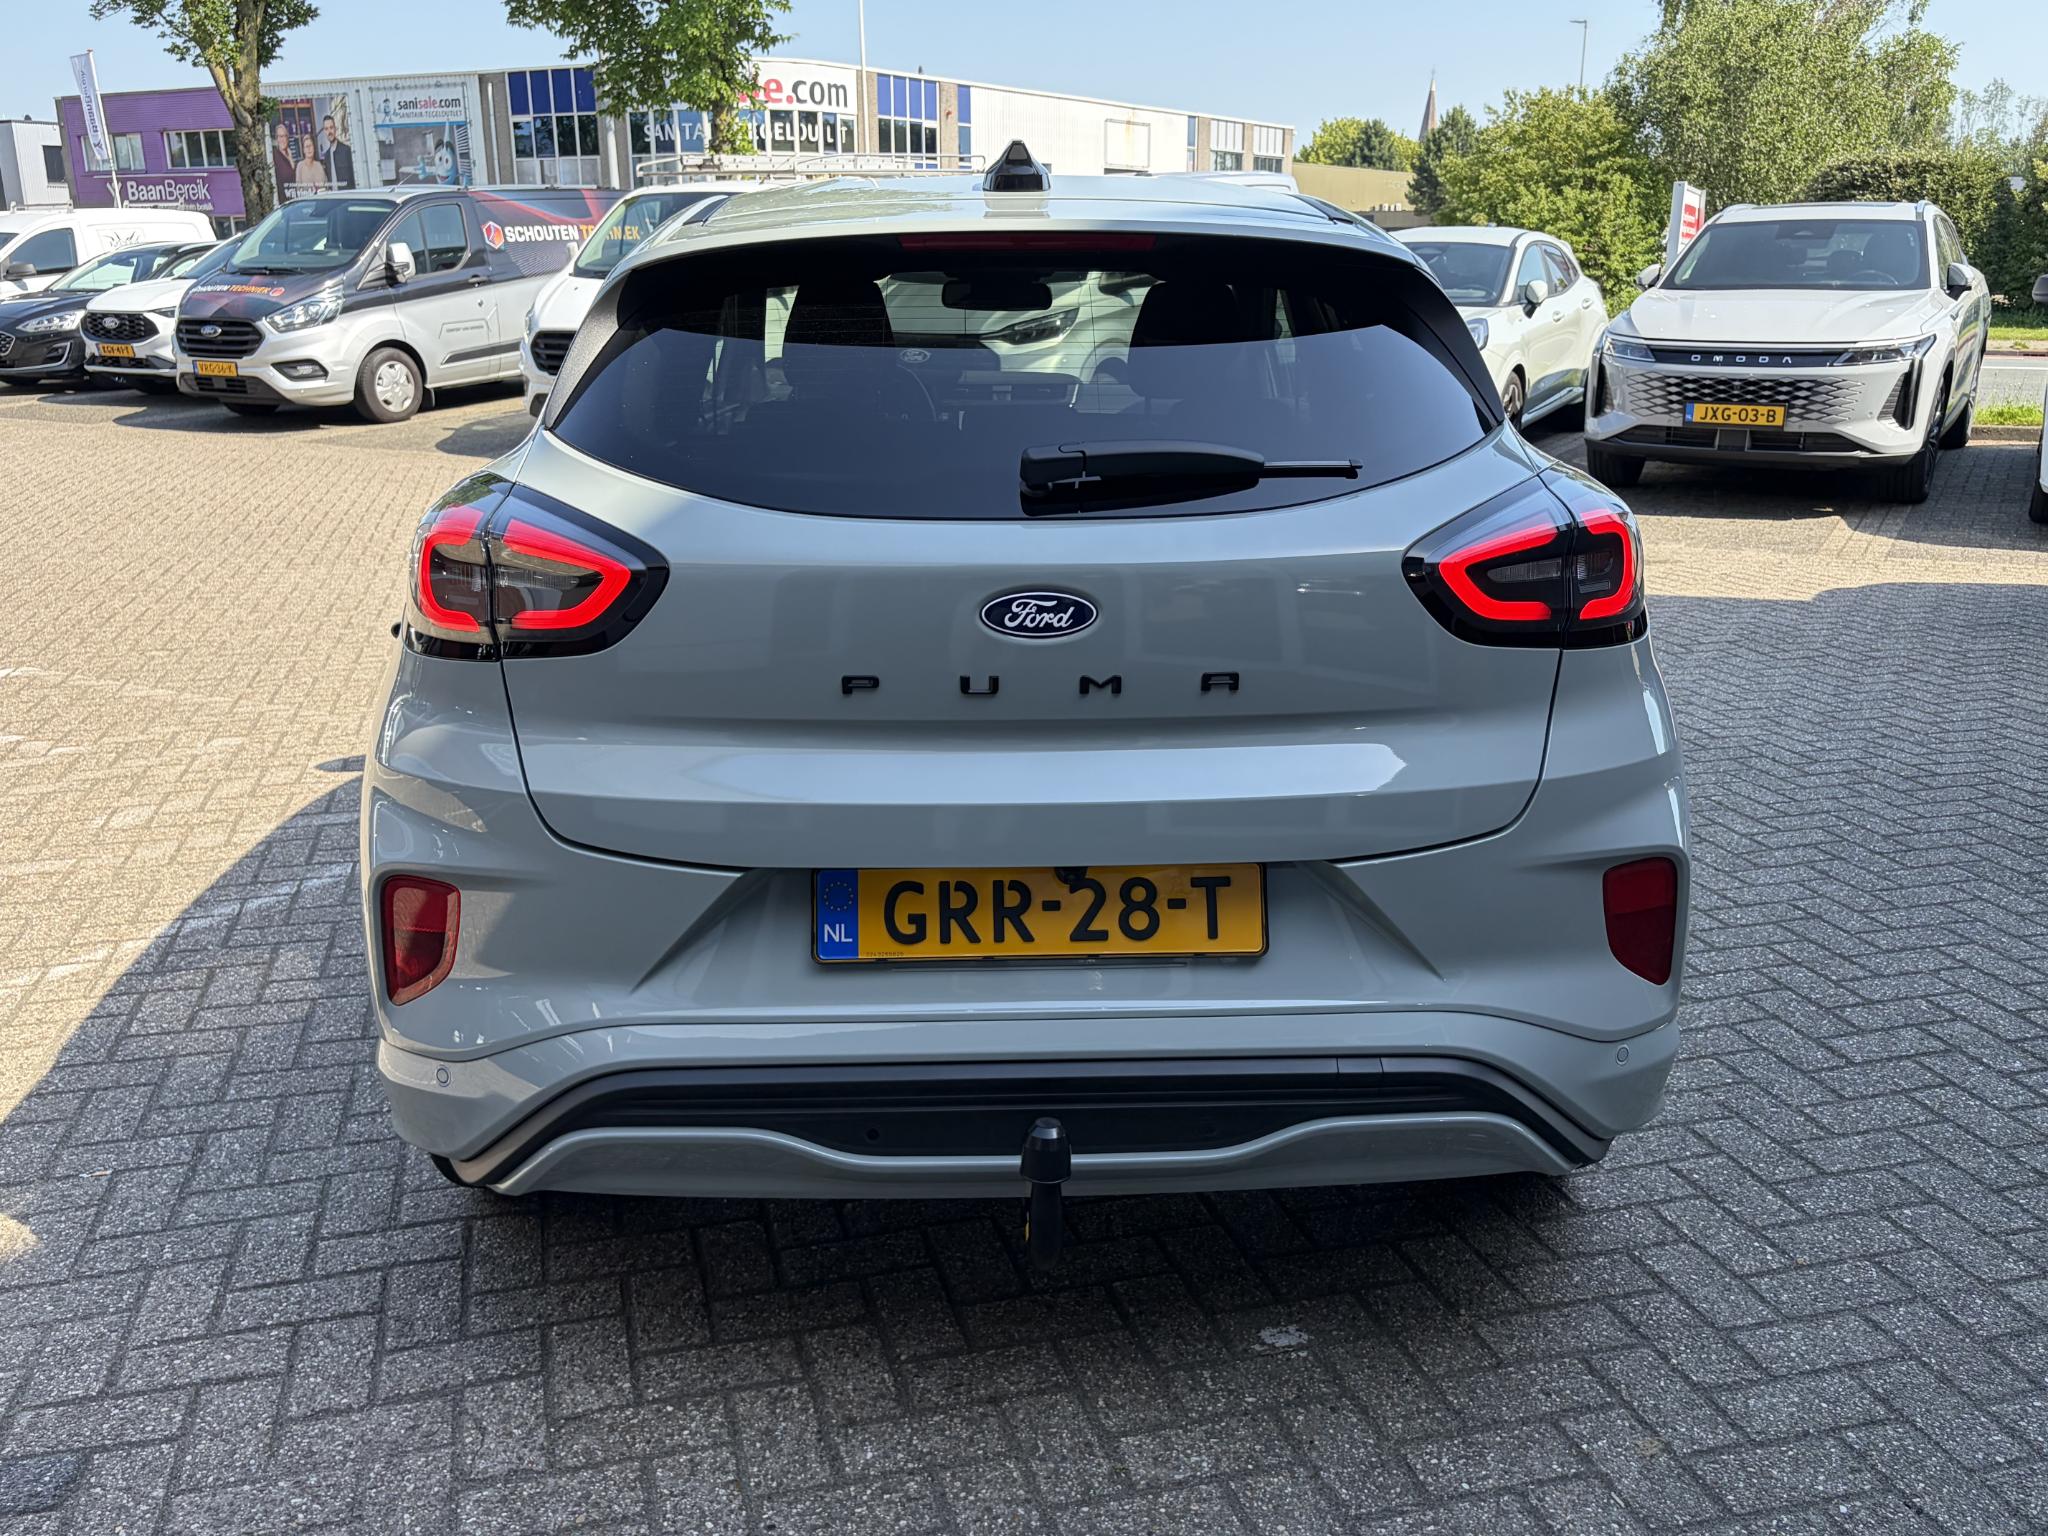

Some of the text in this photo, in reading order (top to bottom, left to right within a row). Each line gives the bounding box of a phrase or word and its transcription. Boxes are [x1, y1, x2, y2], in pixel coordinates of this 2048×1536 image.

[397, 95, 461, 111] sanisale.com
[739, 78, 848, 108] e.com
[126, 179, 211, 201] BaanBereik
[504, 224, 579, 243] SCHOUTEN
[1691, 354, 1792, 364] OMODA
[1699, 406, 1777, 423] JXG-03-B
[1004, 599, 1073, 629] Ford
[841, 671, 1240, 695] PUMA
[823, 876, 1232, 945] NL GRR-28-T
